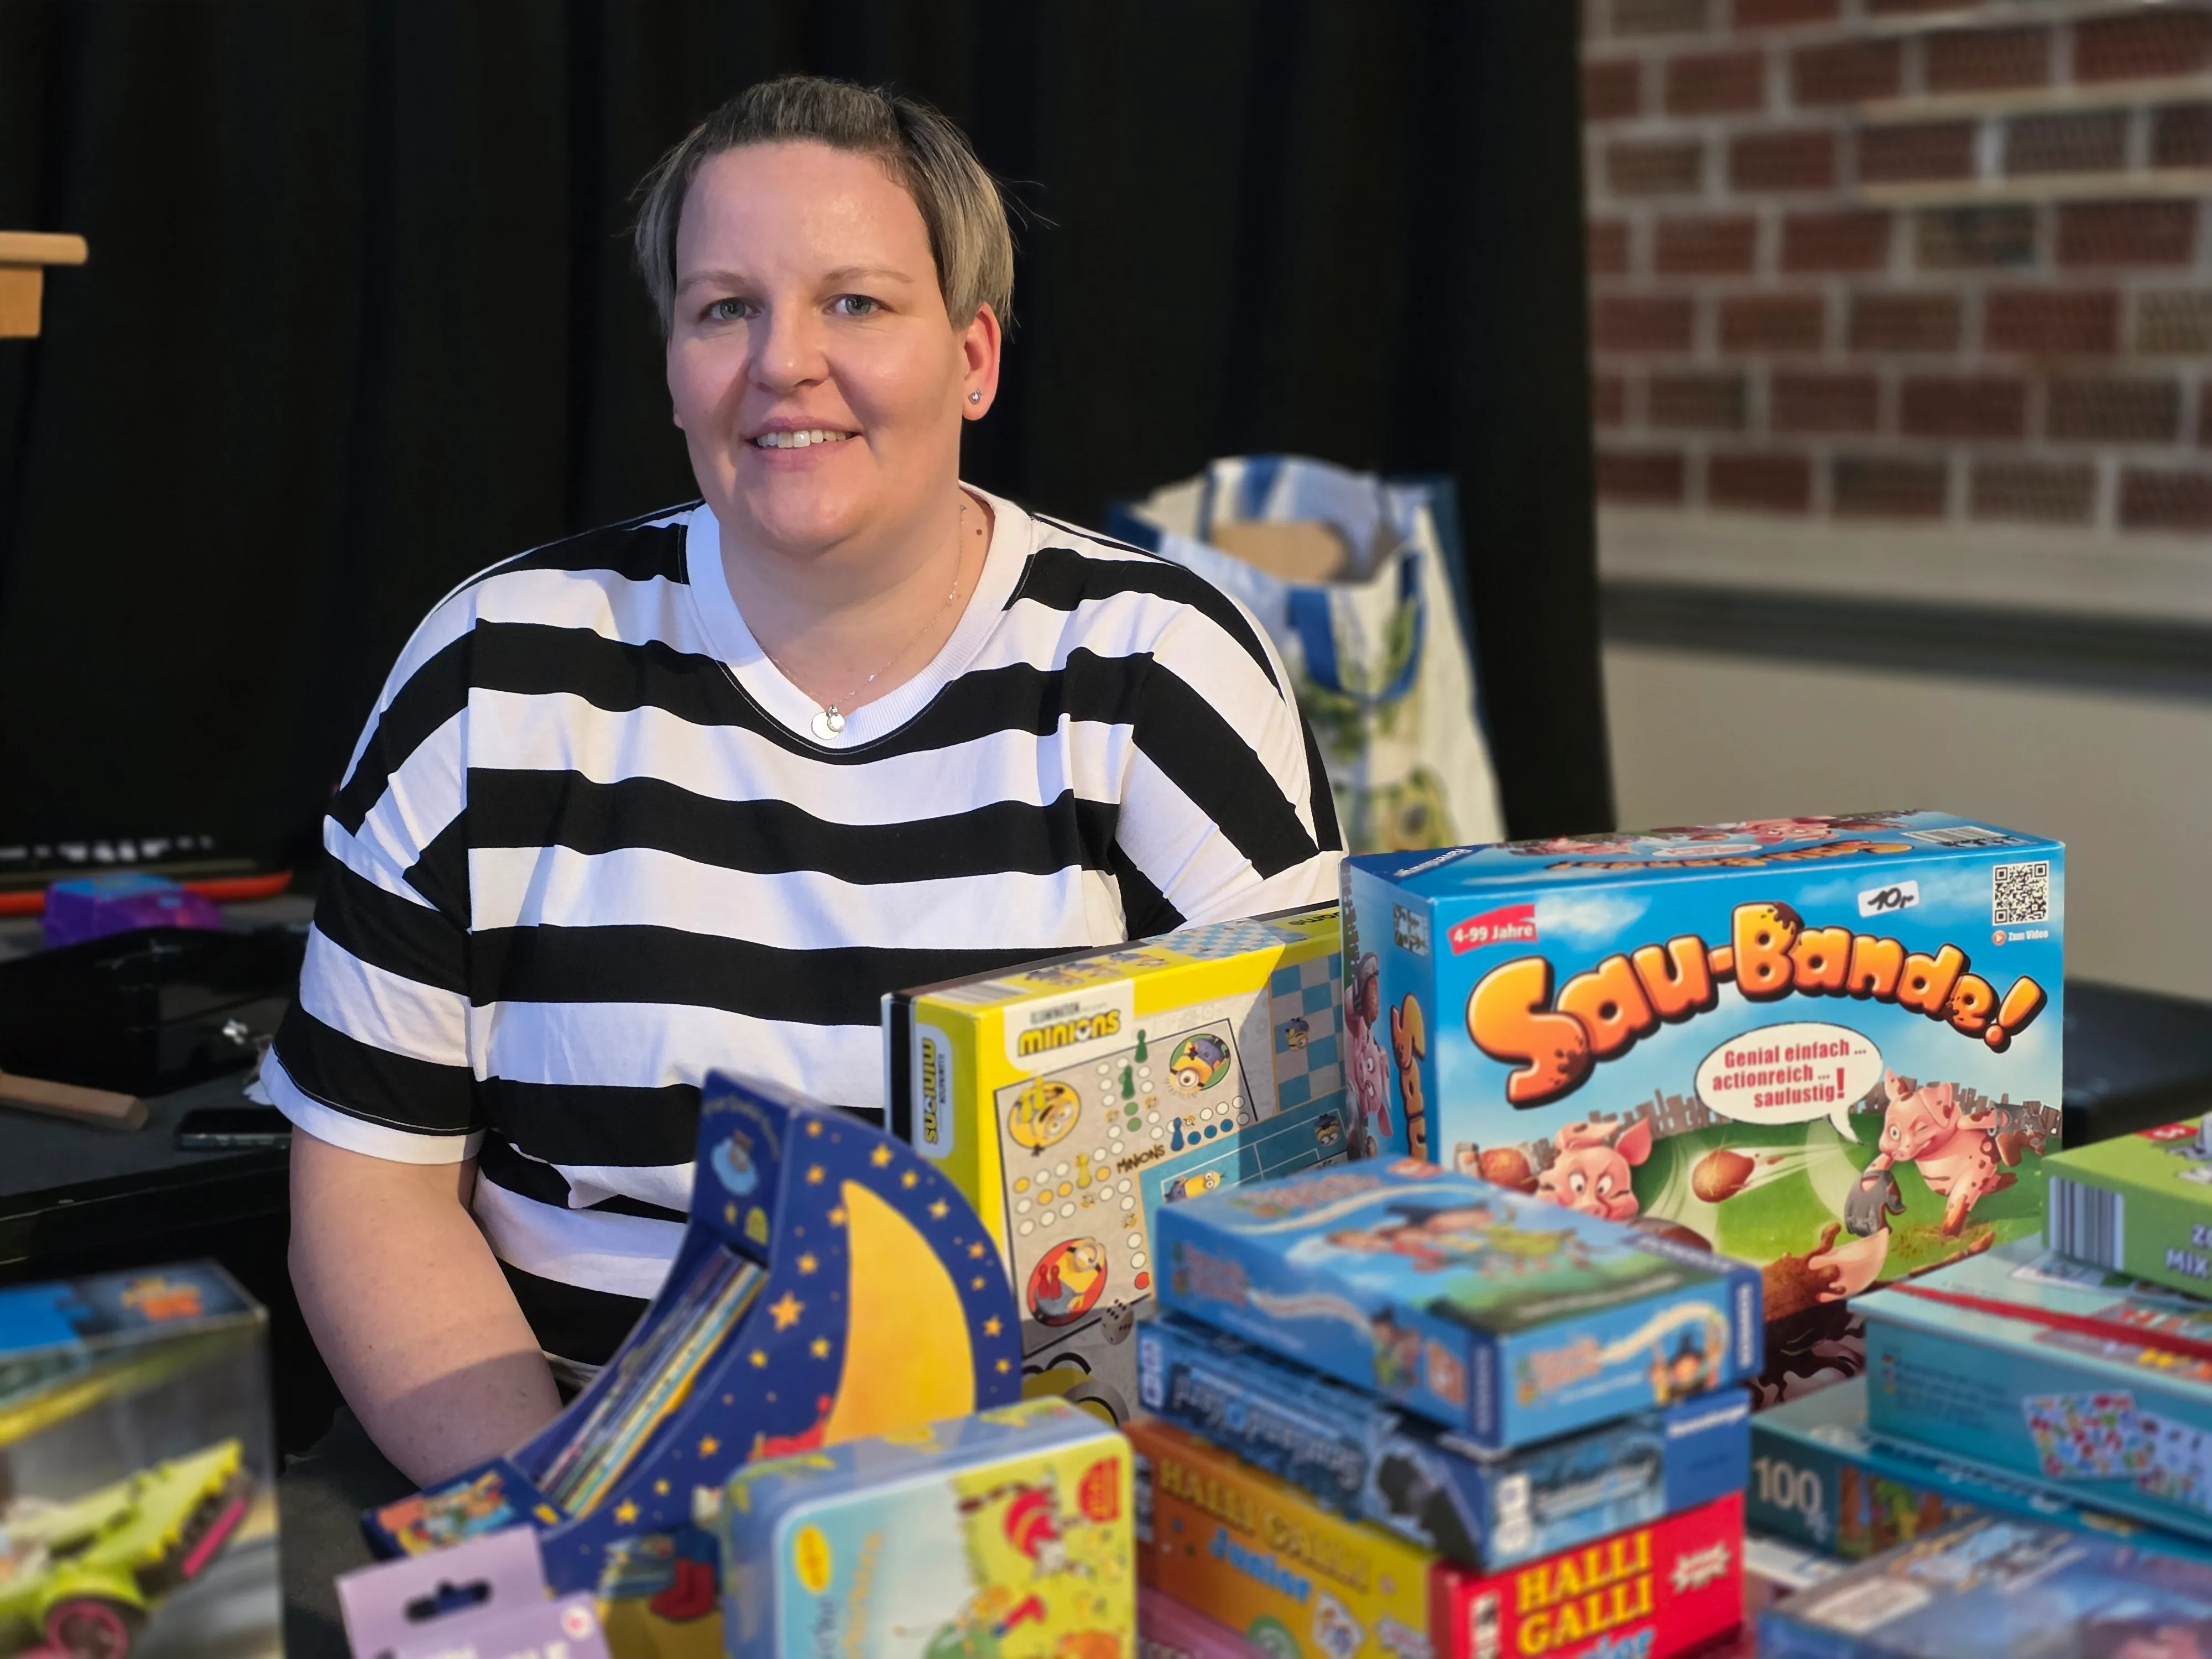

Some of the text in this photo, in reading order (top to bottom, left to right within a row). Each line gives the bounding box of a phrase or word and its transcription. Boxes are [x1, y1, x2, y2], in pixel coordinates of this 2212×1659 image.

[1454, 924, 1533, 943] 4-99 Jahre
[2007, 929, 2049, 941] Zum Video
[1467, 901, 2047, 1109] Sau-Bande!
[1724, 1045, 1780, 1068] Genial
[1785, 1039, 1850, 1062] einfach
[1713, 1064, 1814, 1092] actionreich
[1754, 1067, 1845, 1108] saulustig!
[1117, 1144, 1166, 1174] MINIONS
[2166, 1247, 2209, 1279] MIX
[1160, 1458, 1255, 1534] HALLI
[1752, 1454, 1823, 1514] 100
[1516, 1530, 1653, 1615] HALLI
[1517, 1574, 1653, 1655] GALLI
